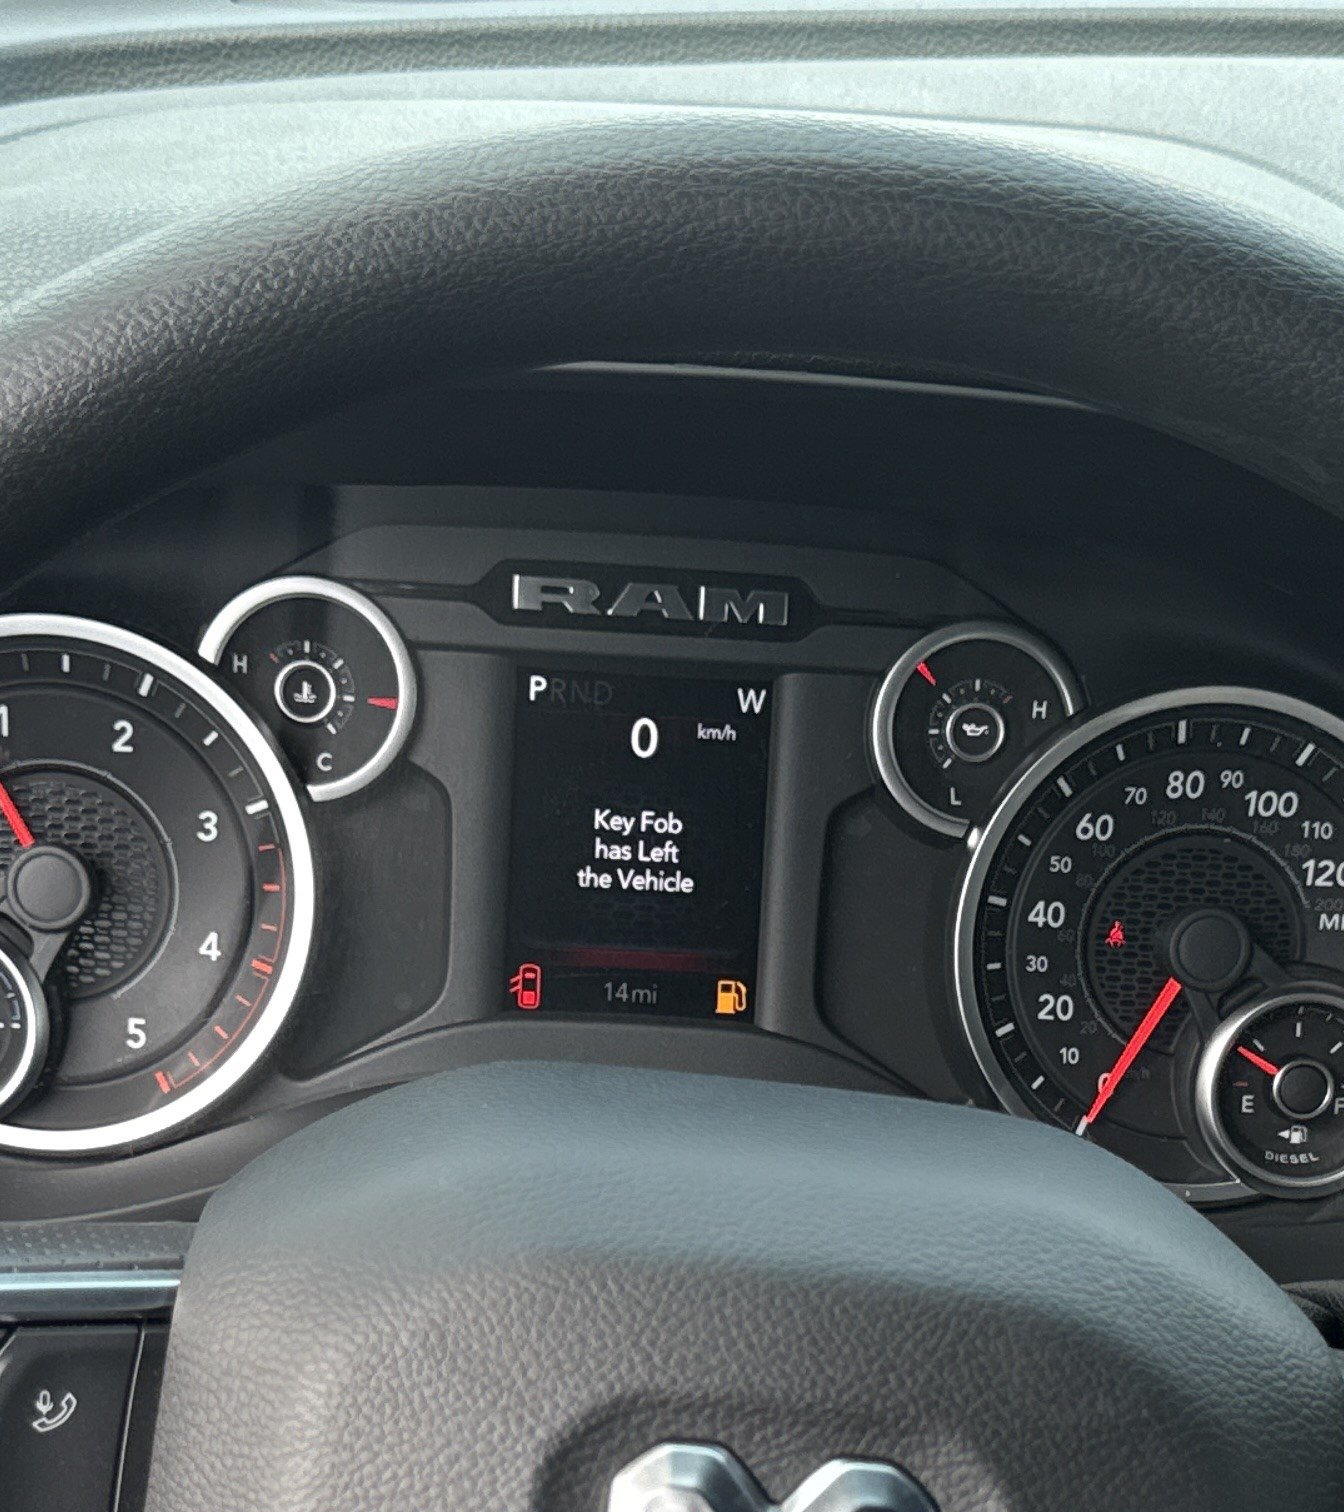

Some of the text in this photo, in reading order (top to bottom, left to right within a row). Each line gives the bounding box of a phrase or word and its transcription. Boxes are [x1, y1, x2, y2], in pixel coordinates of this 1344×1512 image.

[513, 574, 789, 626] RAM
[232, 656, 247, 675] H
[737, 688, 767, 715] W
[1032, 700, 1048, 719] H
[112, 719, 134, 753] 2
[630, 716, 659, 759] 0
[697, 722, 736, 742] km/h
[316, 752, 333, 772] C
[1166, 770, 1205, 799] 80
[1220, 770, 1244, 790] 90
[950, 786, 962, 805] L
[1124, 786, 1148, 806] 70
[1244, 789, 1299, 818] 100
[197, 810, 219, 842] 3
[594, 808, 683, 836] Key Fob
[1075, 813, 1114, 841] 60
[1301, 821, 1334, 840] 110
[595, 838, 679, 864] has Left
[1049, 856, 1072, 874] 50
[577, 866, 694, 894] the Vehicle
[1027, 901, 1066, 929] 40
[198, 932, 222, 961] 4
[1025, 955, 1049, 974] 30
[1037, 994, 1073, 1021] 20
[126, 1018, 147, 1048] 5
[1059, 1046, 1080, 1066] 10
[1241, 1095, 1255, 1114] E
[1264, 1150, 1320, 1165] DIESEL
